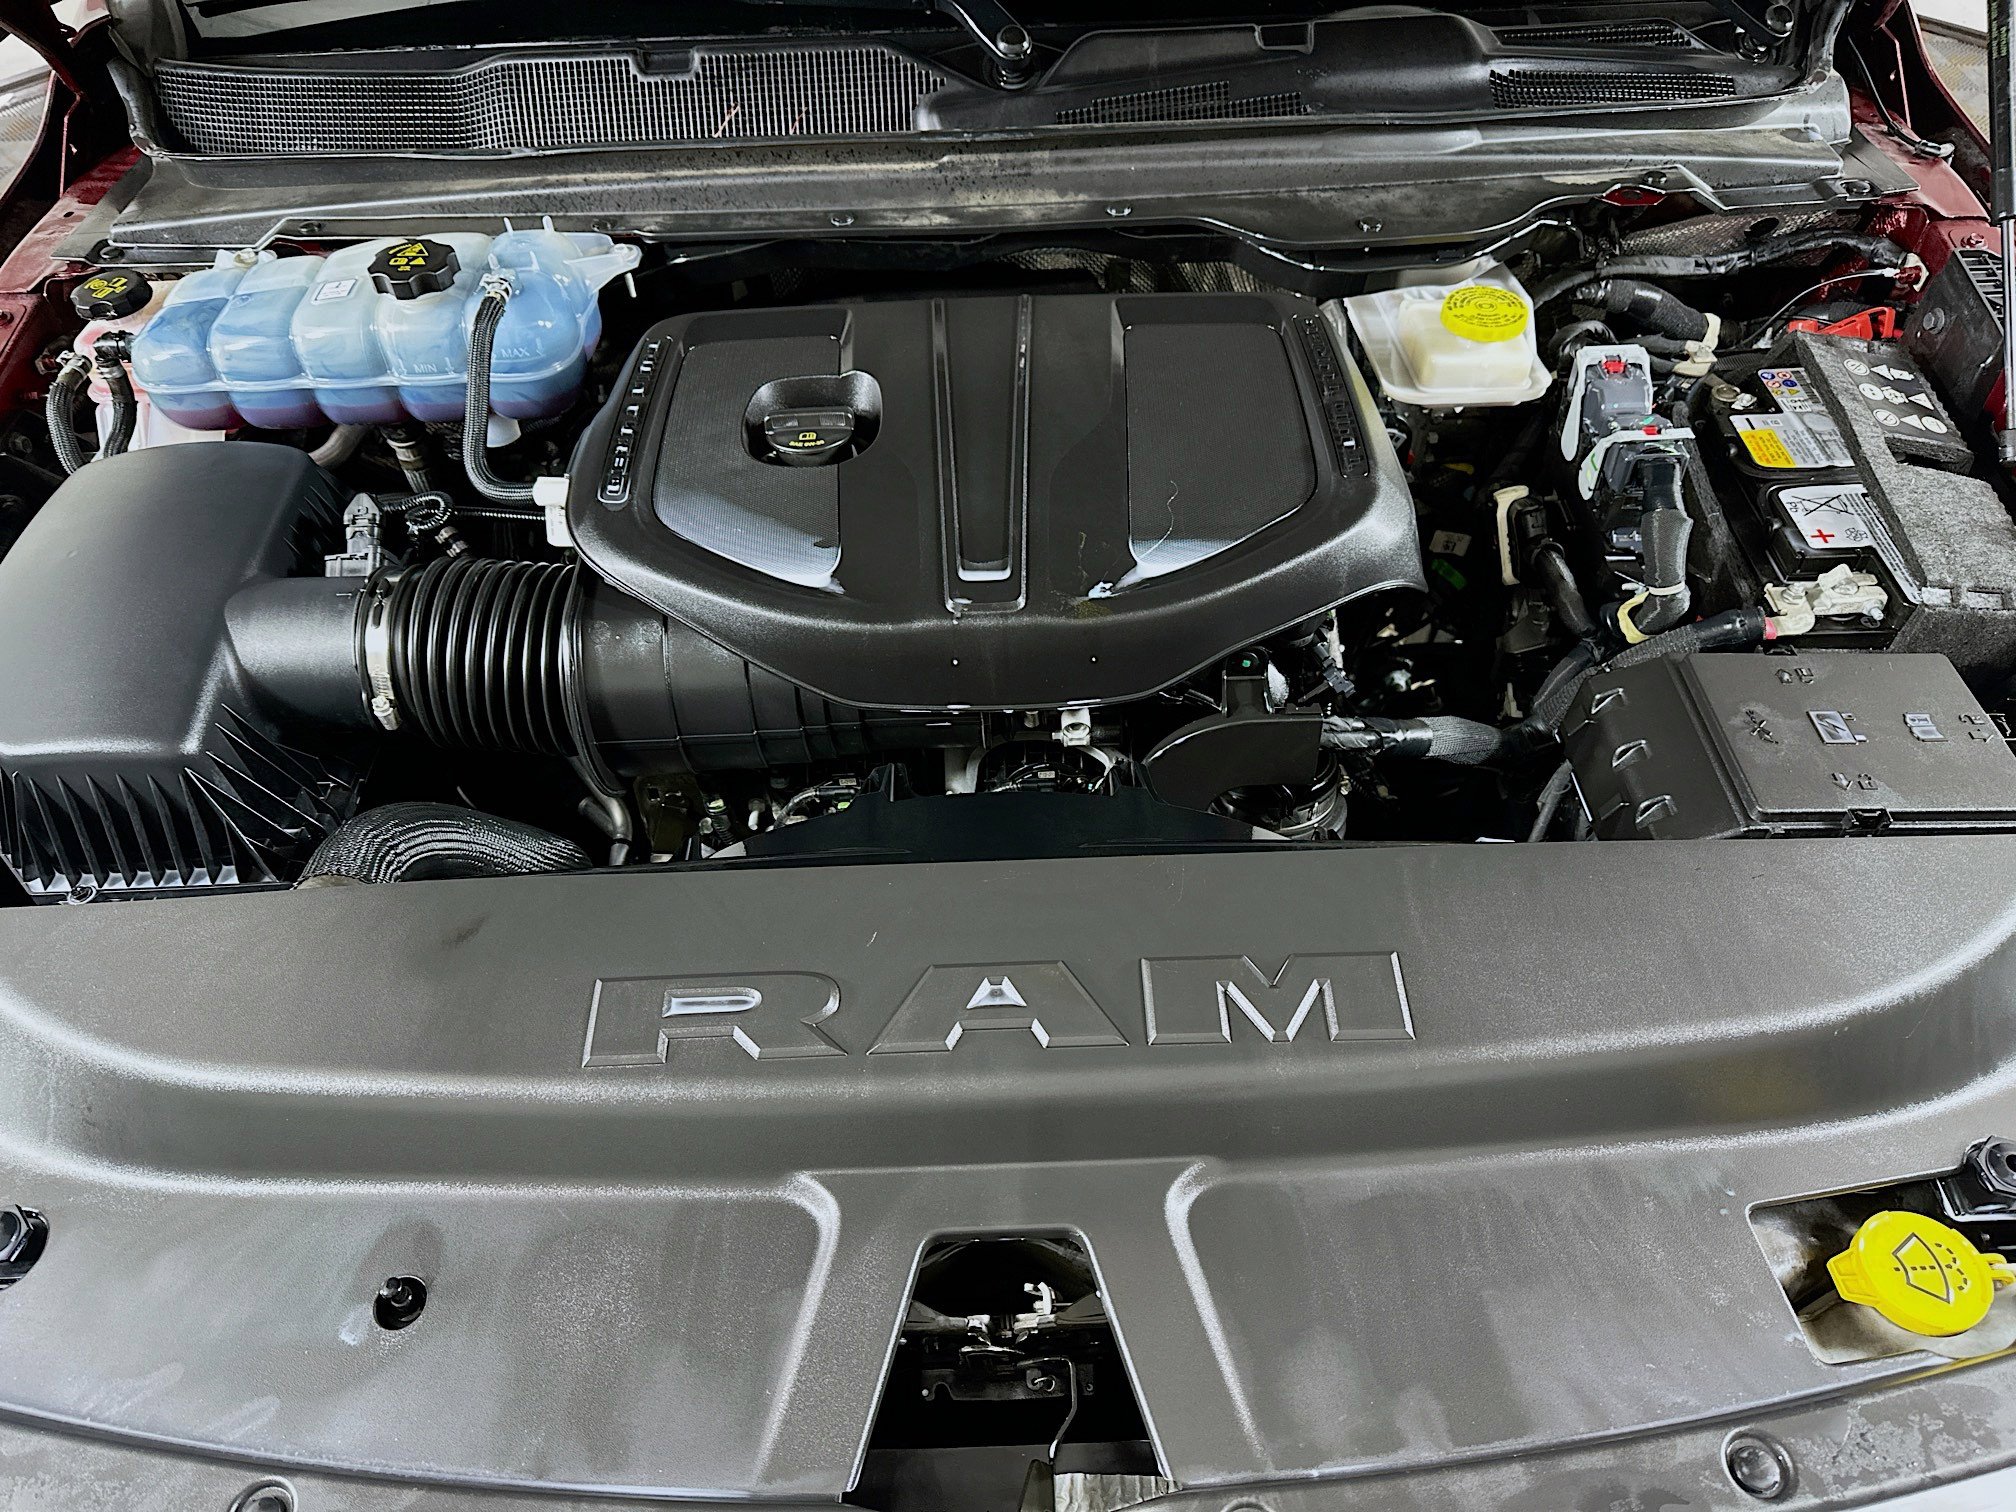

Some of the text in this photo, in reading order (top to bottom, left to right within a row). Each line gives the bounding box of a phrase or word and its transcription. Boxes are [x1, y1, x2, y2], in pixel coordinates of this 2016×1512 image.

[501, 348, 530, 358] MAX
[413, 363, 438, 373] MIN
[581, 951, 1415, 1068] RAM
